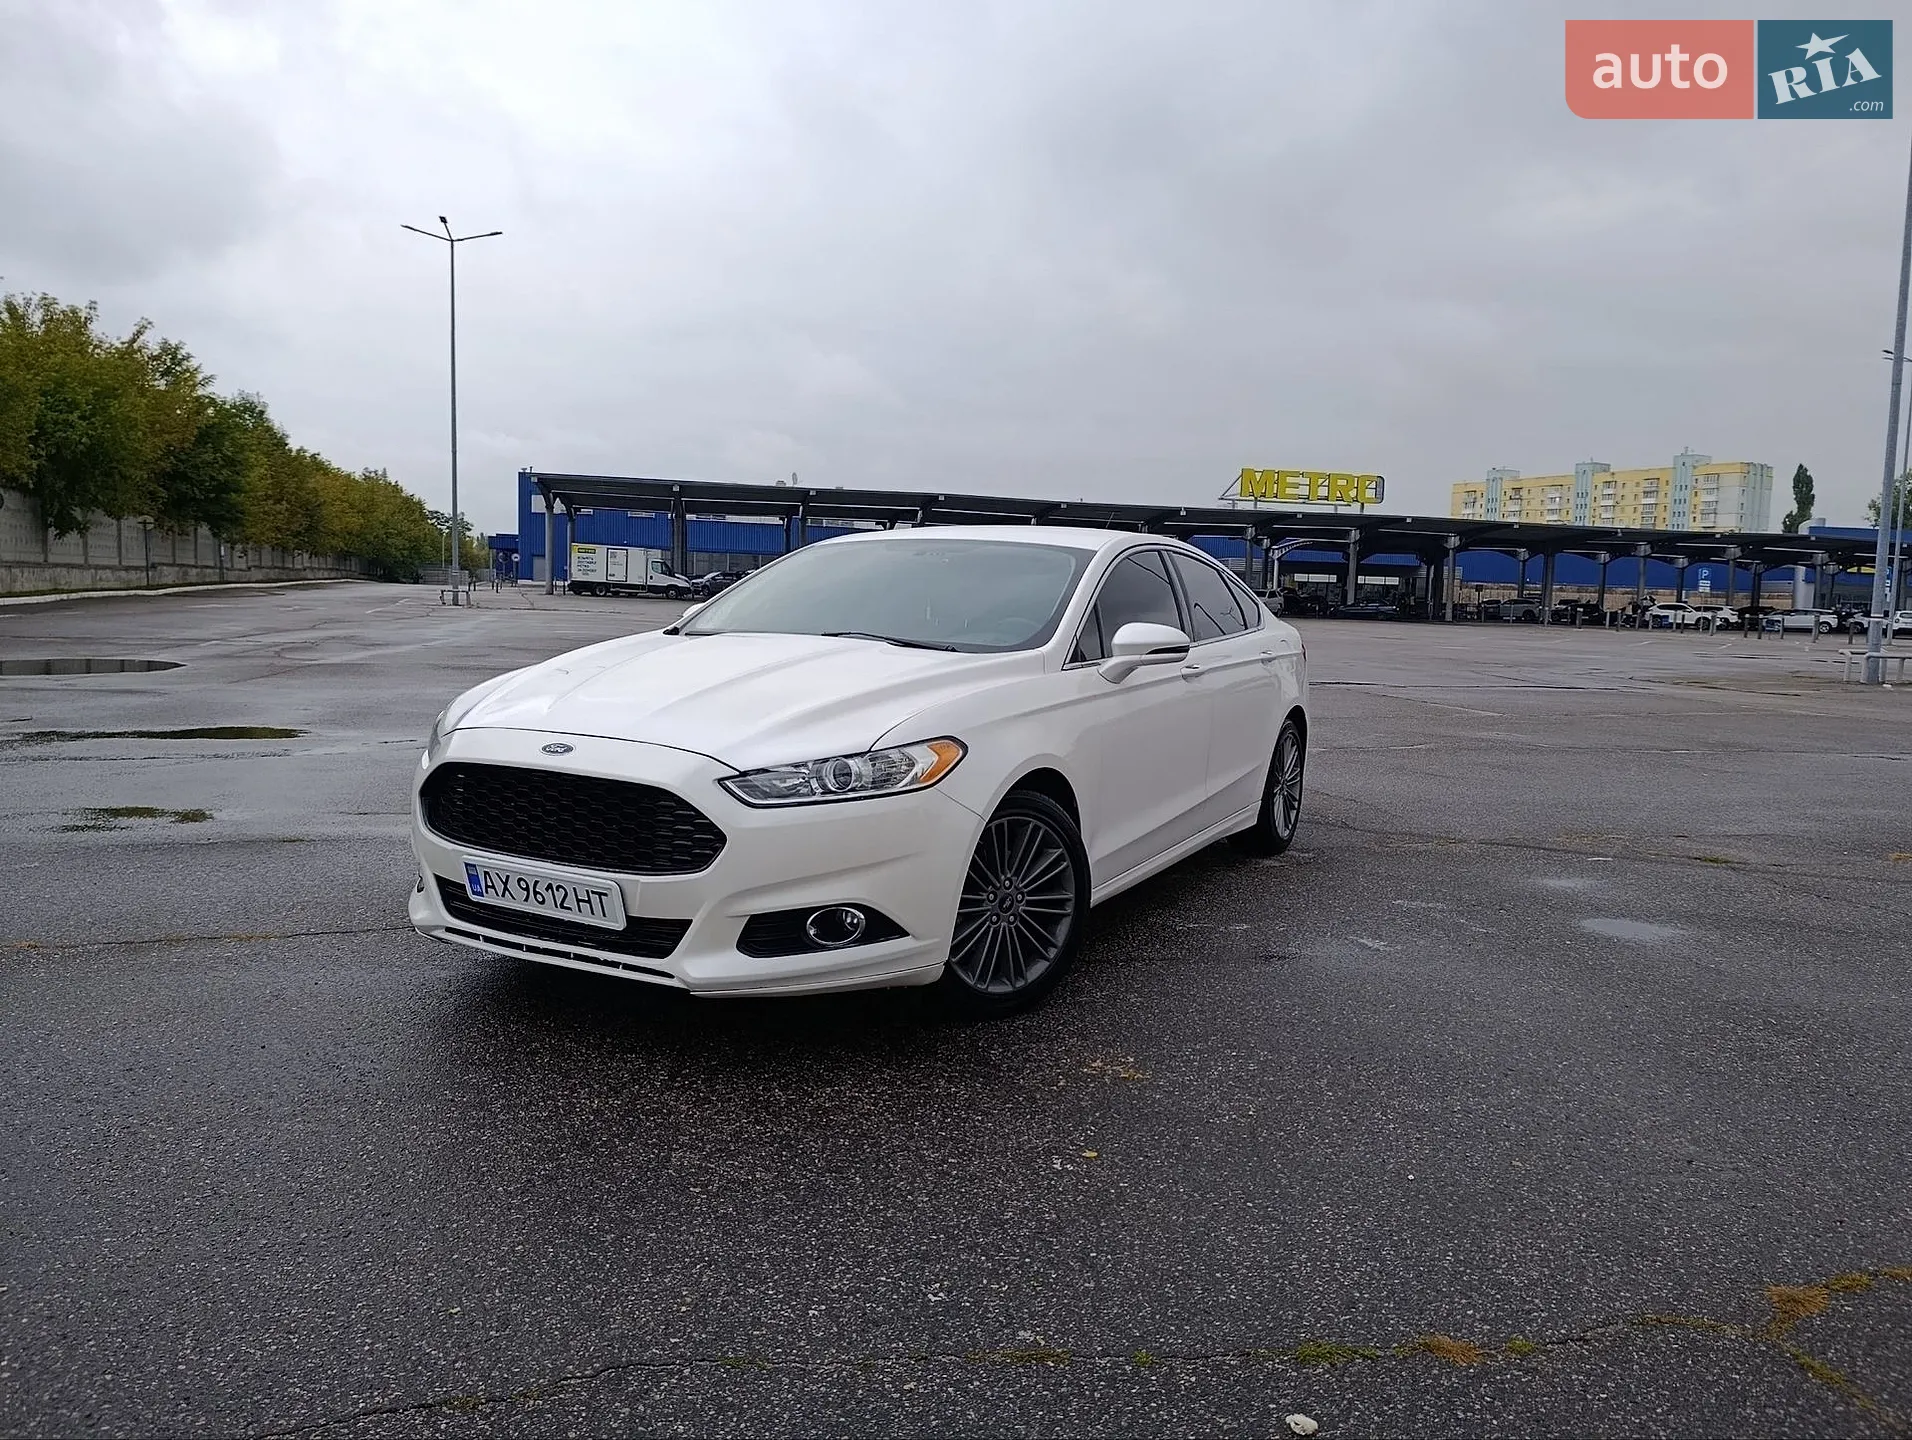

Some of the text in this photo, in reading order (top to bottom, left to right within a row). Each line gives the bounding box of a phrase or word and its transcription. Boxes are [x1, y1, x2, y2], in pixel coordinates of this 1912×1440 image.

[1240, 468, 1385, 504] METRO
[1701, 569, 1709, 579] P
[483, 870, 608, 917] AX 9612 HT
